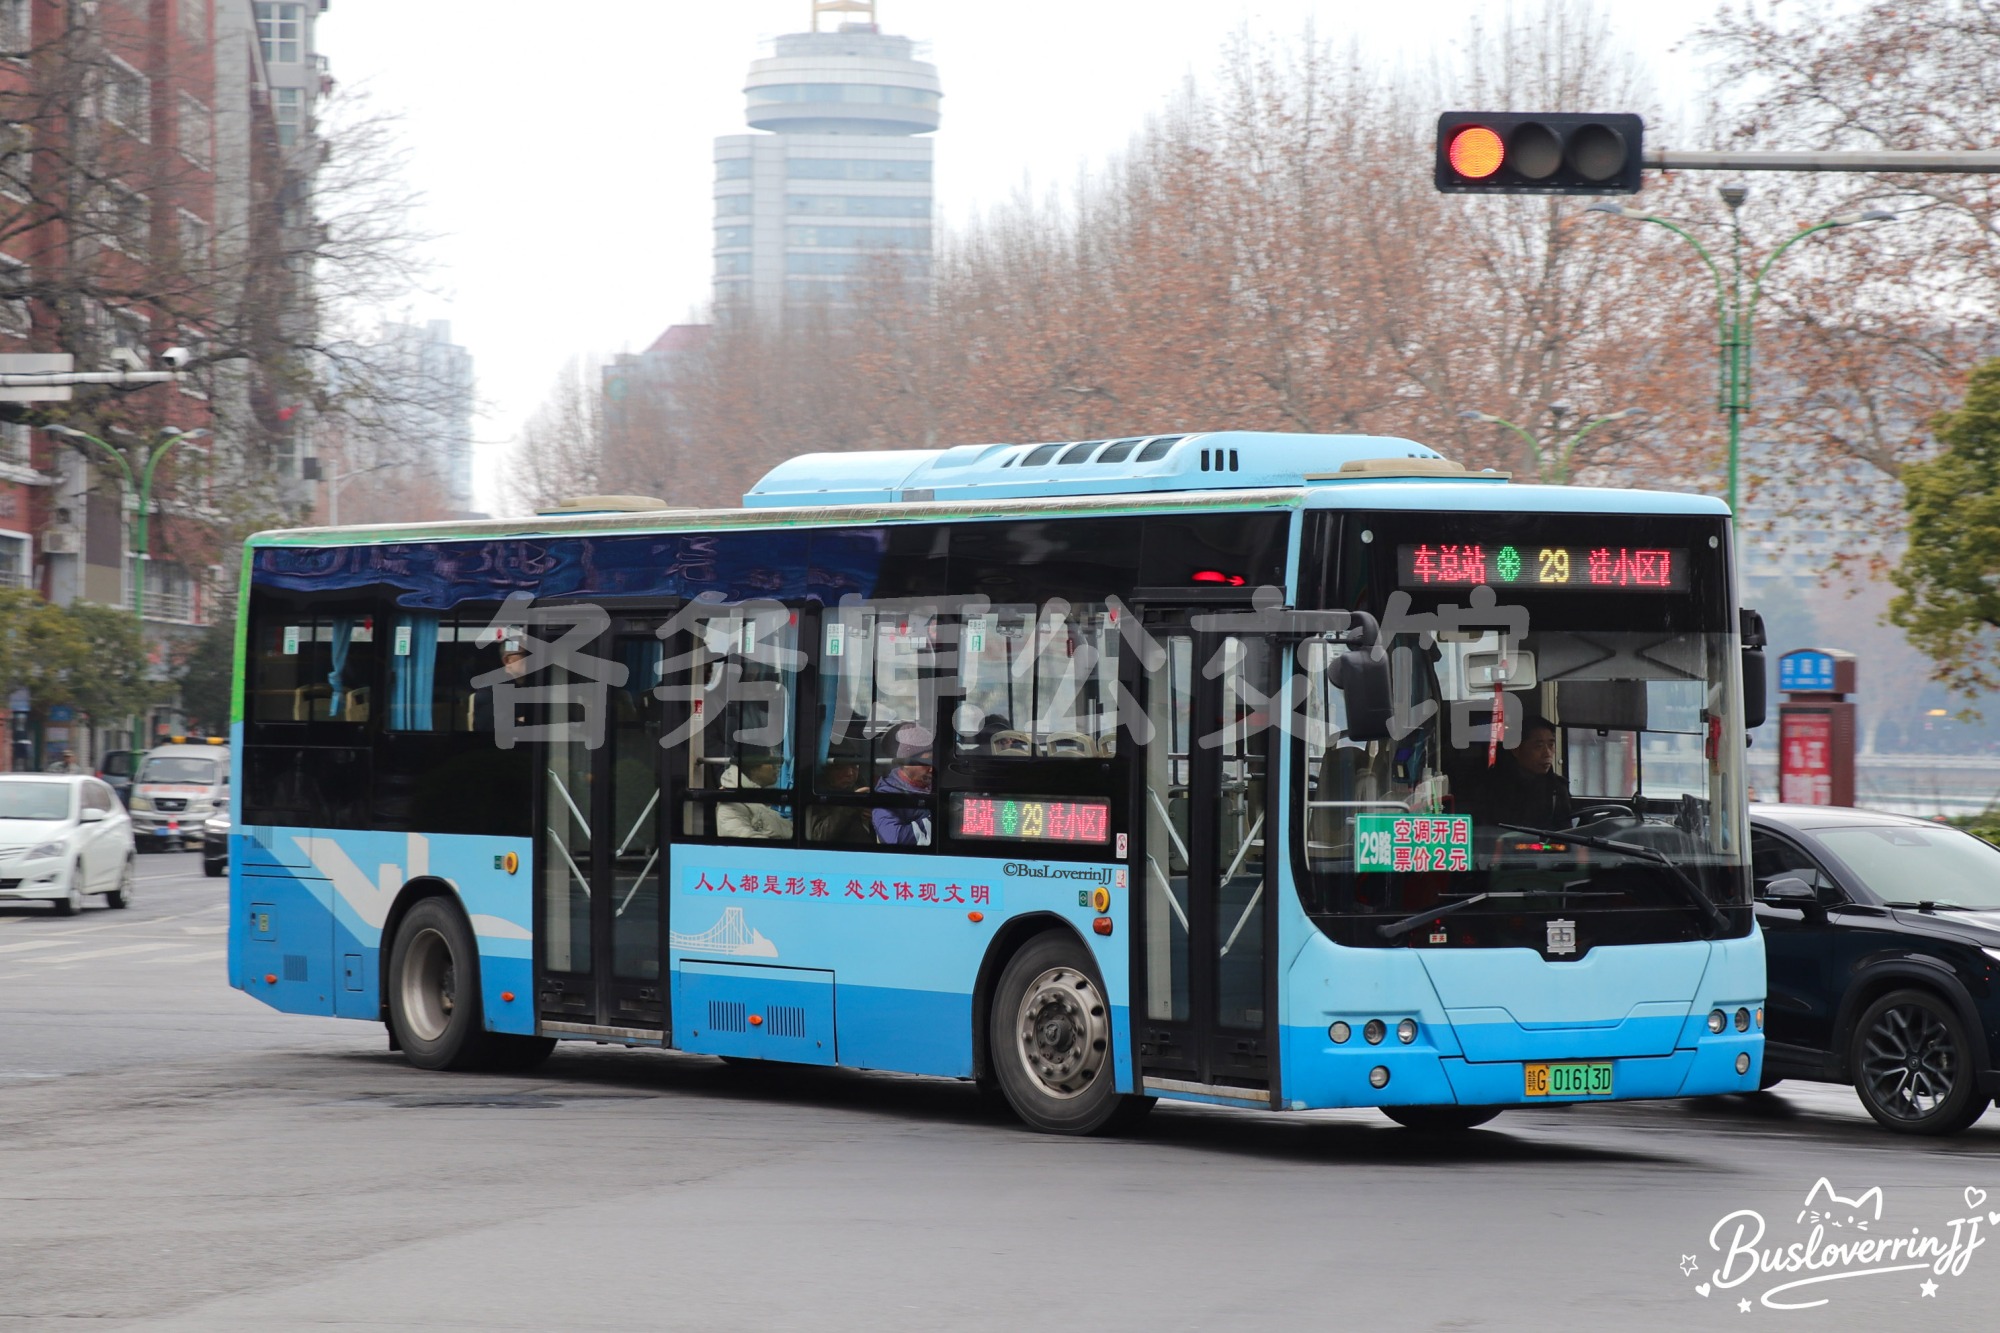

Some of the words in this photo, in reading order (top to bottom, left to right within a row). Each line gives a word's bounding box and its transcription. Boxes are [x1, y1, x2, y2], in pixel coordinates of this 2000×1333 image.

[1413, 544, 1485, 584] 车总站
[1538, 548, 1569, 583] 29
[1022, 803, 1043, 836] 29
[1394, 819, 1468, 844] 空调开启
[1394, 846, 1468, 872] 票价2元
[694, 872, 830, 898] 人人都是形象
[844, 879, 990, 905] 处处体现文明
